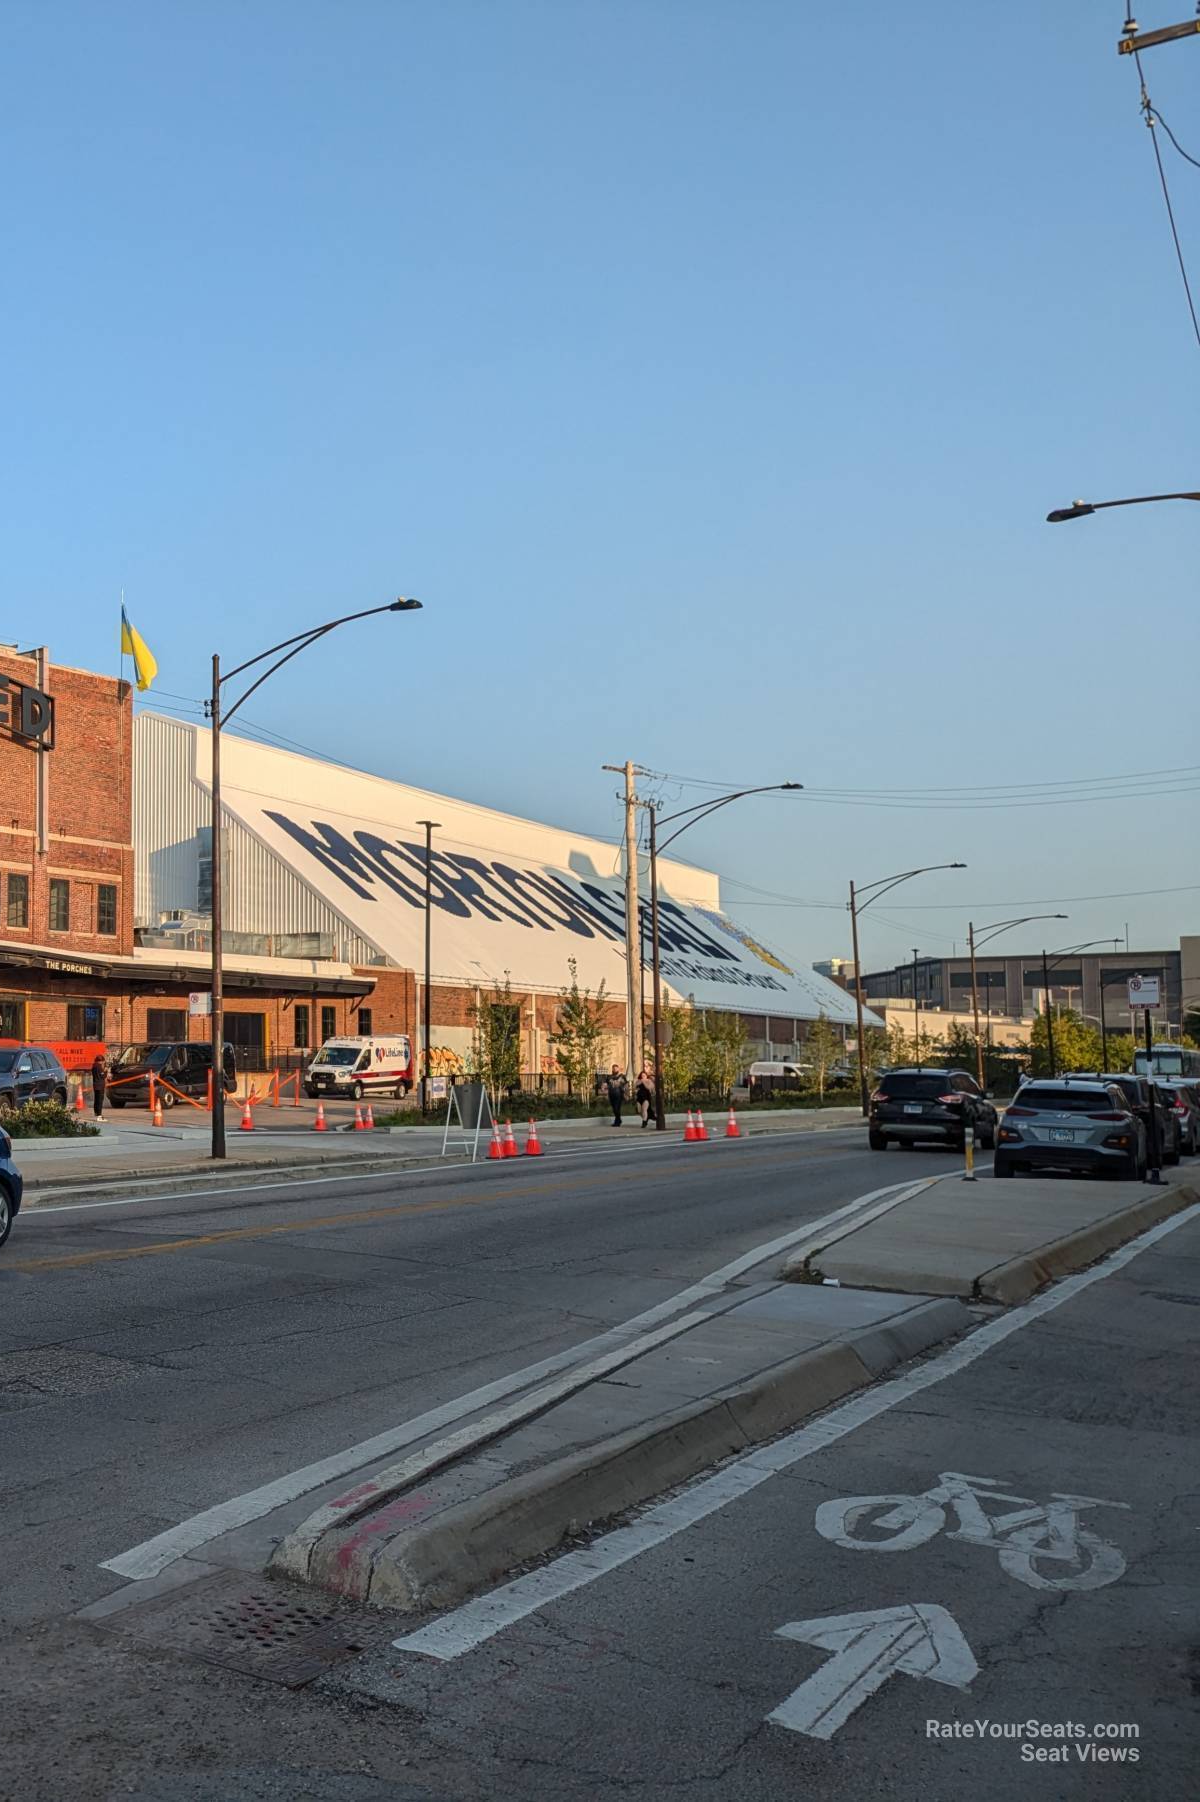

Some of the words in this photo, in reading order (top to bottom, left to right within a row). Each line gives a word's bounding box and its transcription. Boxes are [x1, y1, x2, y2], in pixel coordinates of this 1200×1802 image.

[261, 809, 618, 941] MORTON
[46, 960, 60, 970] THE
[62, 963, 93, 975] PORCHES
[732, 966, 788, 992] Pours
